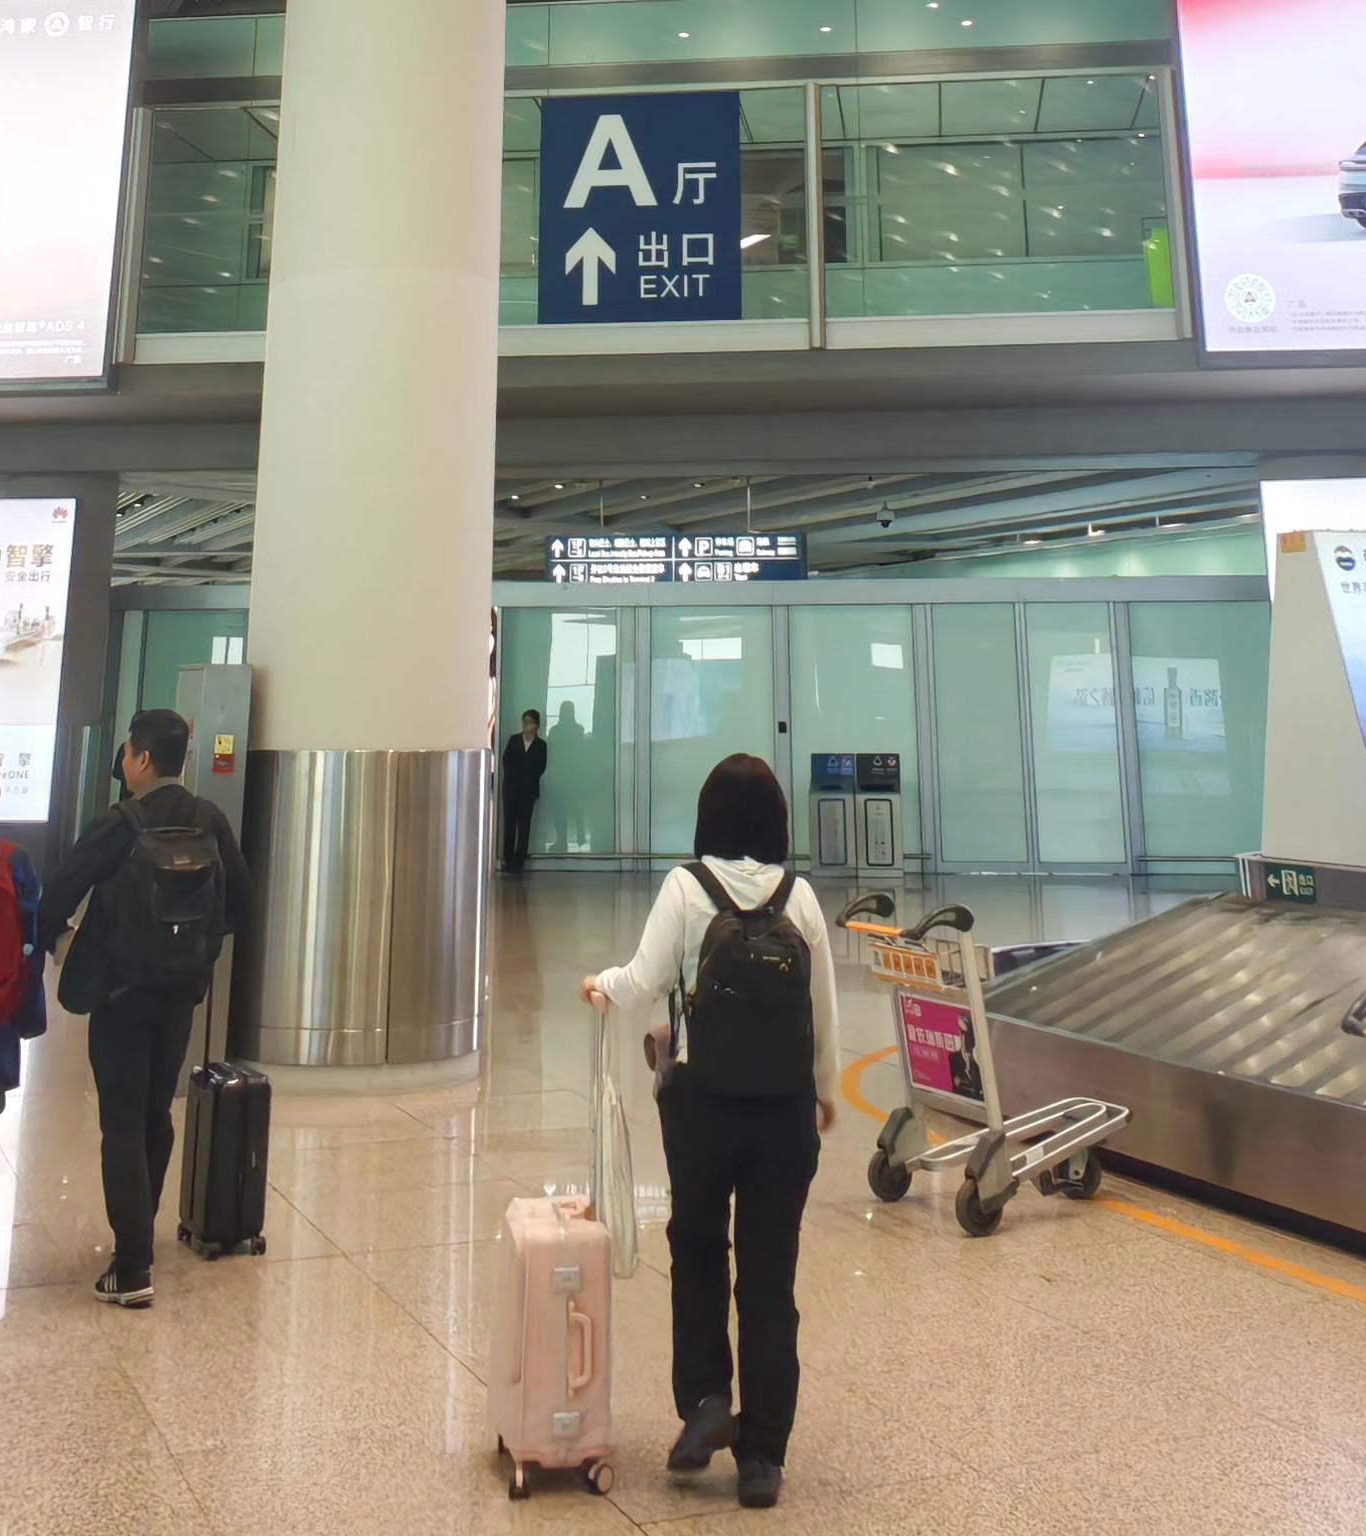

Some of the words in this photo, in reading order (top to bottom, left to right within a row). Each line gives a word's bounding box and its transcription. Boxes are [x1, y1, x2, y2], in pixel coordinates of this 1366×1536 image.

[638, 231, 714, 268] 出口
[640, 274, 711, 299] EXIT
[4, 570, 51, 582] 安全出行
